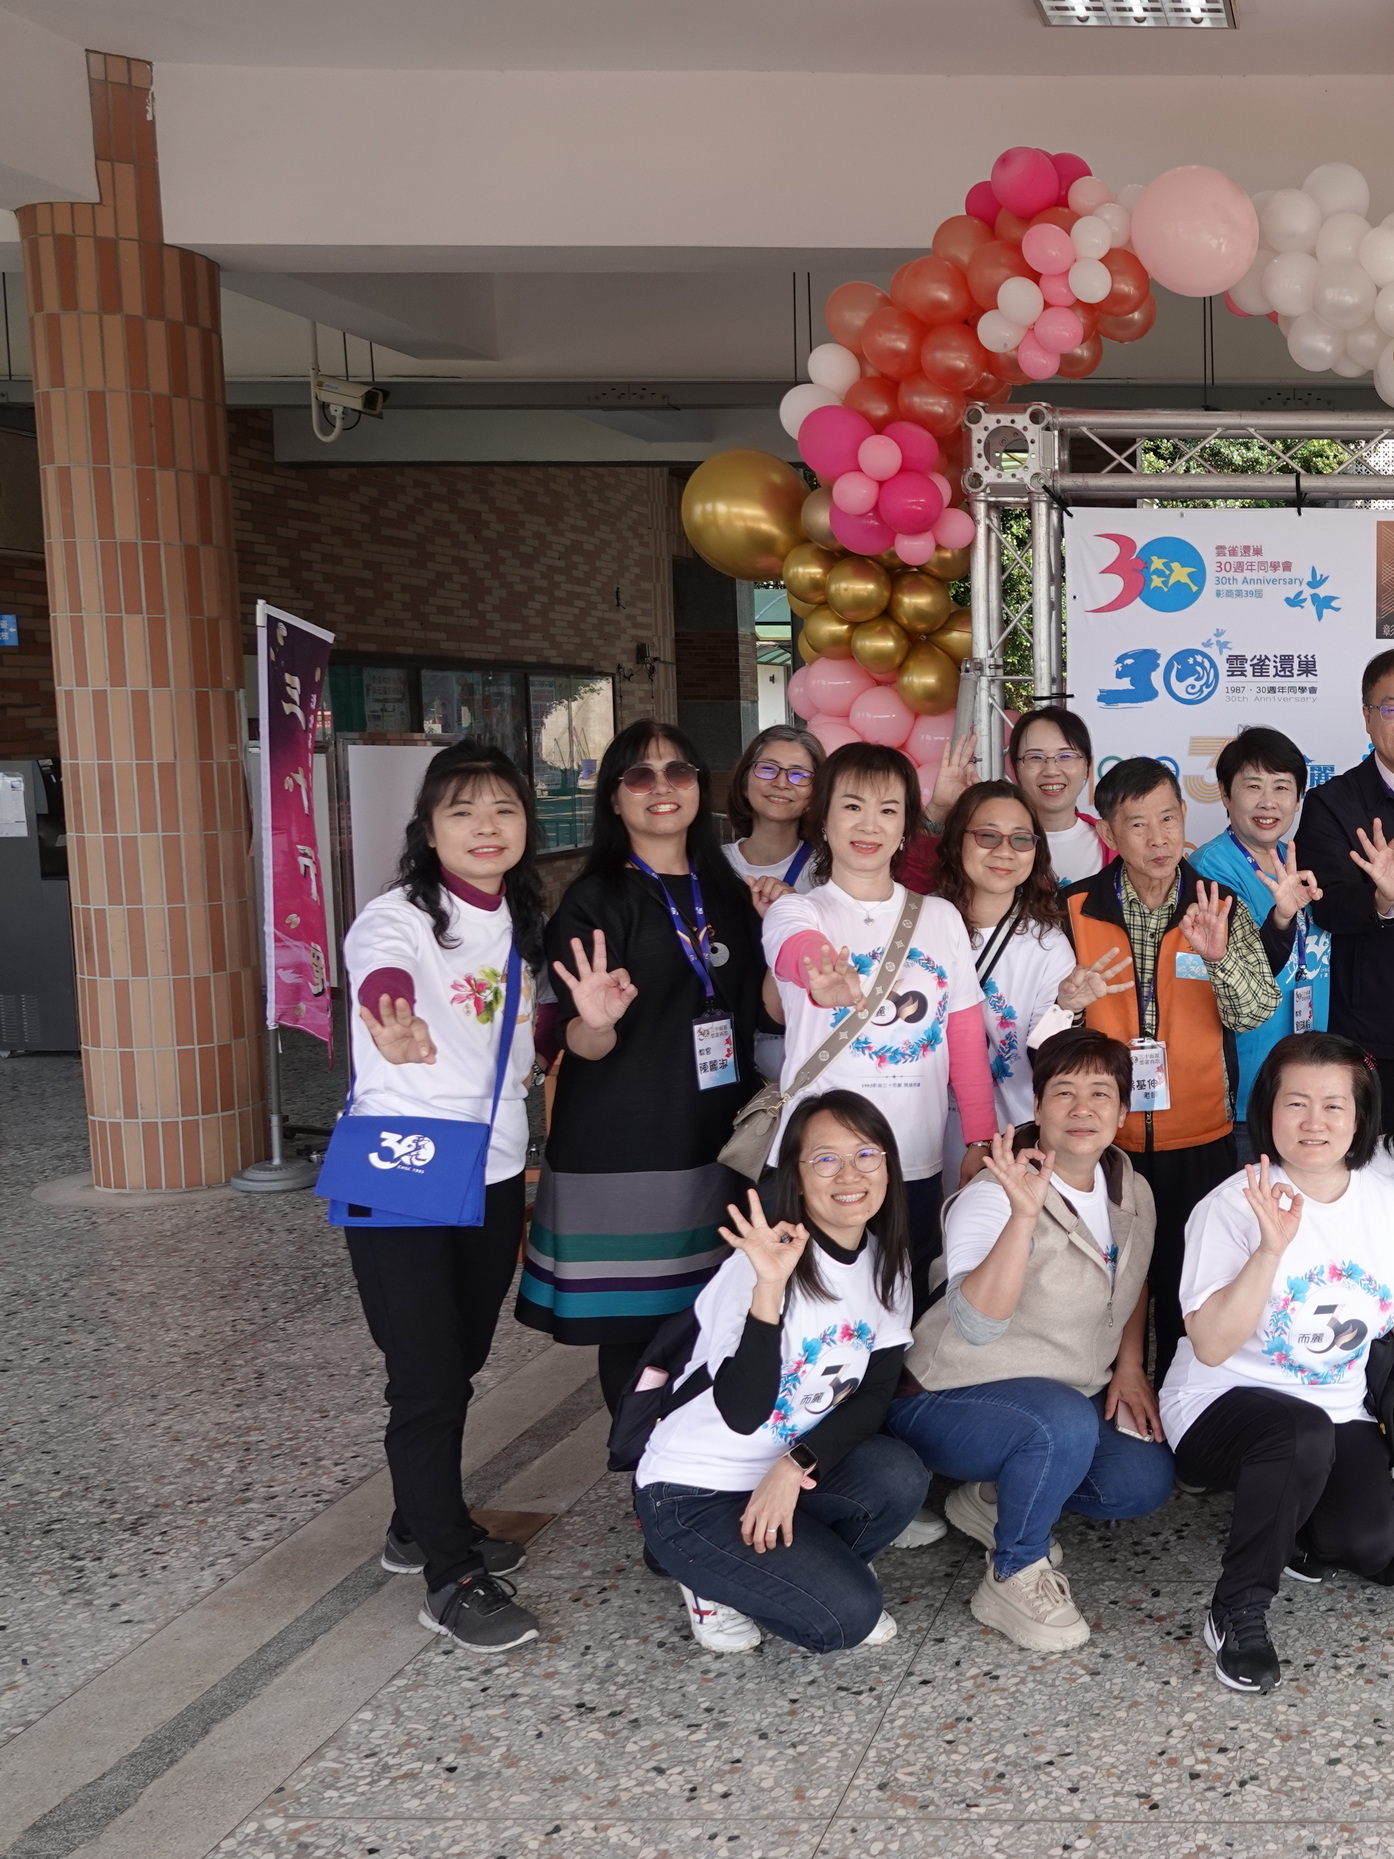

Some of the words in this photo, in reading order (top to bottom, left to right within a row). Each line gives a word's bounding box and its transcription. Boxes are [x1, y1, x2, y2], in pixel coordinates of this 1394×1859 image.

[1215, 545, 1263, 558] 雲雀還巢
[1215, 560, 1293, 574] 30週年同學會
[1214, 575, 1239, 586] 30th
[1241, 575, 1305, 588] Anniversary
[1215, 588, 1264, 599] 彰商第39屆
[1225, 654, 1318, 679] 雲雀還巢
[1225, 686, 1246, 695] 1987
[1256, 685, 1318, 695] 30週年同學會
[1225, 694, 1249, 703] 30th
[1253, 694, 1318, 704] Anniversary
[1298, 1332, 1325, 1344] 而麗
